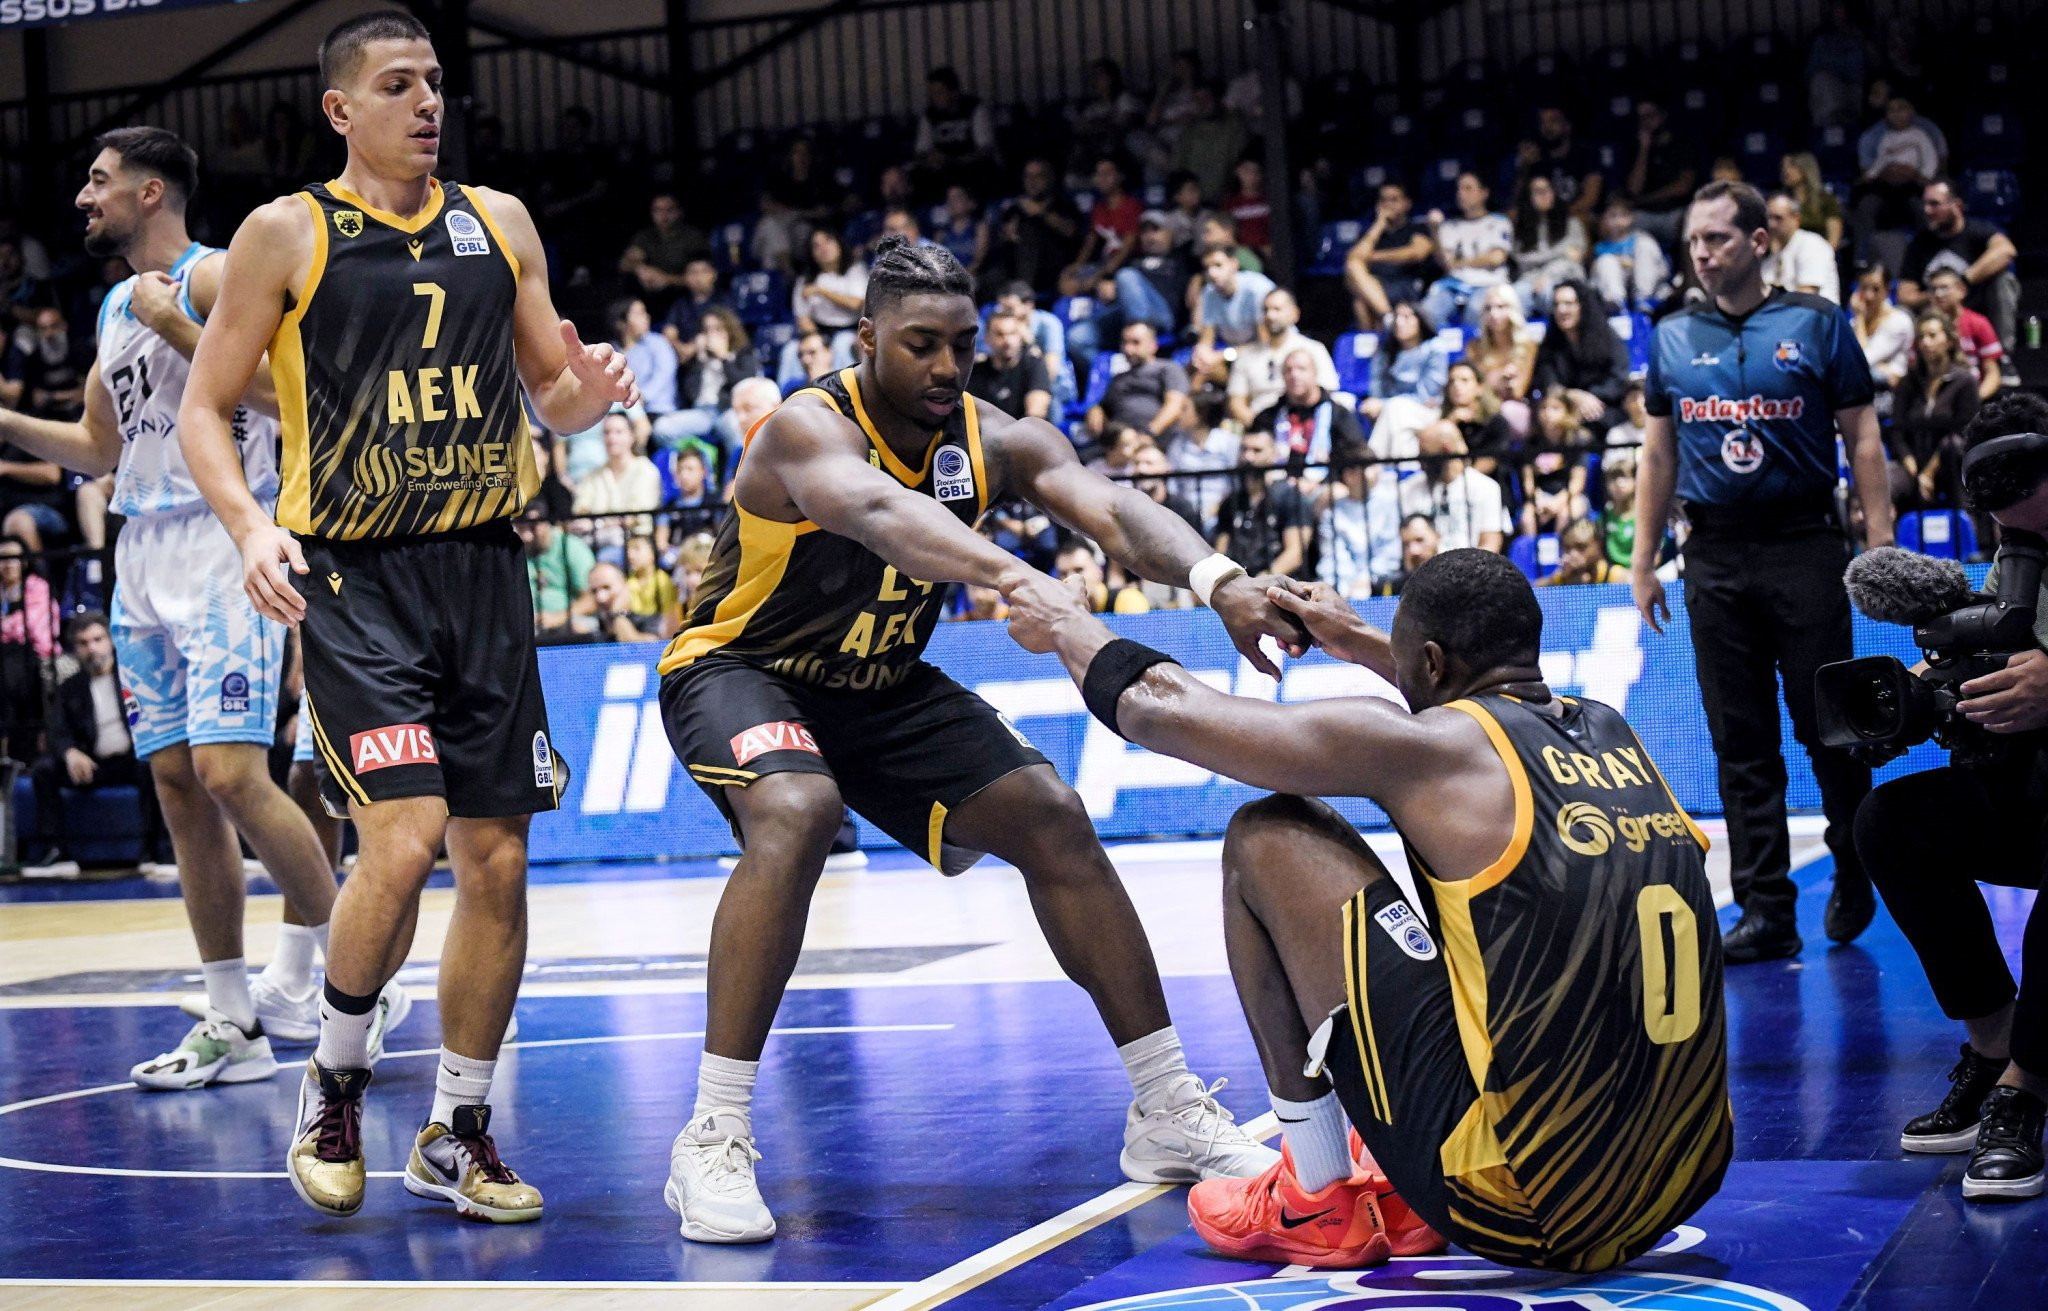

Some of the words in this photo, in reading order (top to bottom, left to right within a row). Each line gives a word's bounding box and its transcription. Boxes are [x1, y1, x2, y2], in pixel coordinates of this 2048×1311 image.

[457, 242, 486, 253] GBL
[413, 282, 446, 349] 7
[387, 364, 483, 425] AEK
[1681, 396, 1802, 423] Palaplast
[407, 478, 482, 493] Empowering
[938, 484, 970, 498] GBL
[358, 728, 436, 769] AVIS
[741, 724, 819, 762] AVIS
[537, 771, 553, 784] GBL
[1542, 745, 1652, 790] GRAY
[1616, 812, 1689, 853] gree
[1380, 904, 1409, 923] GBL
[1637, 884, 1700, 1045] 0
